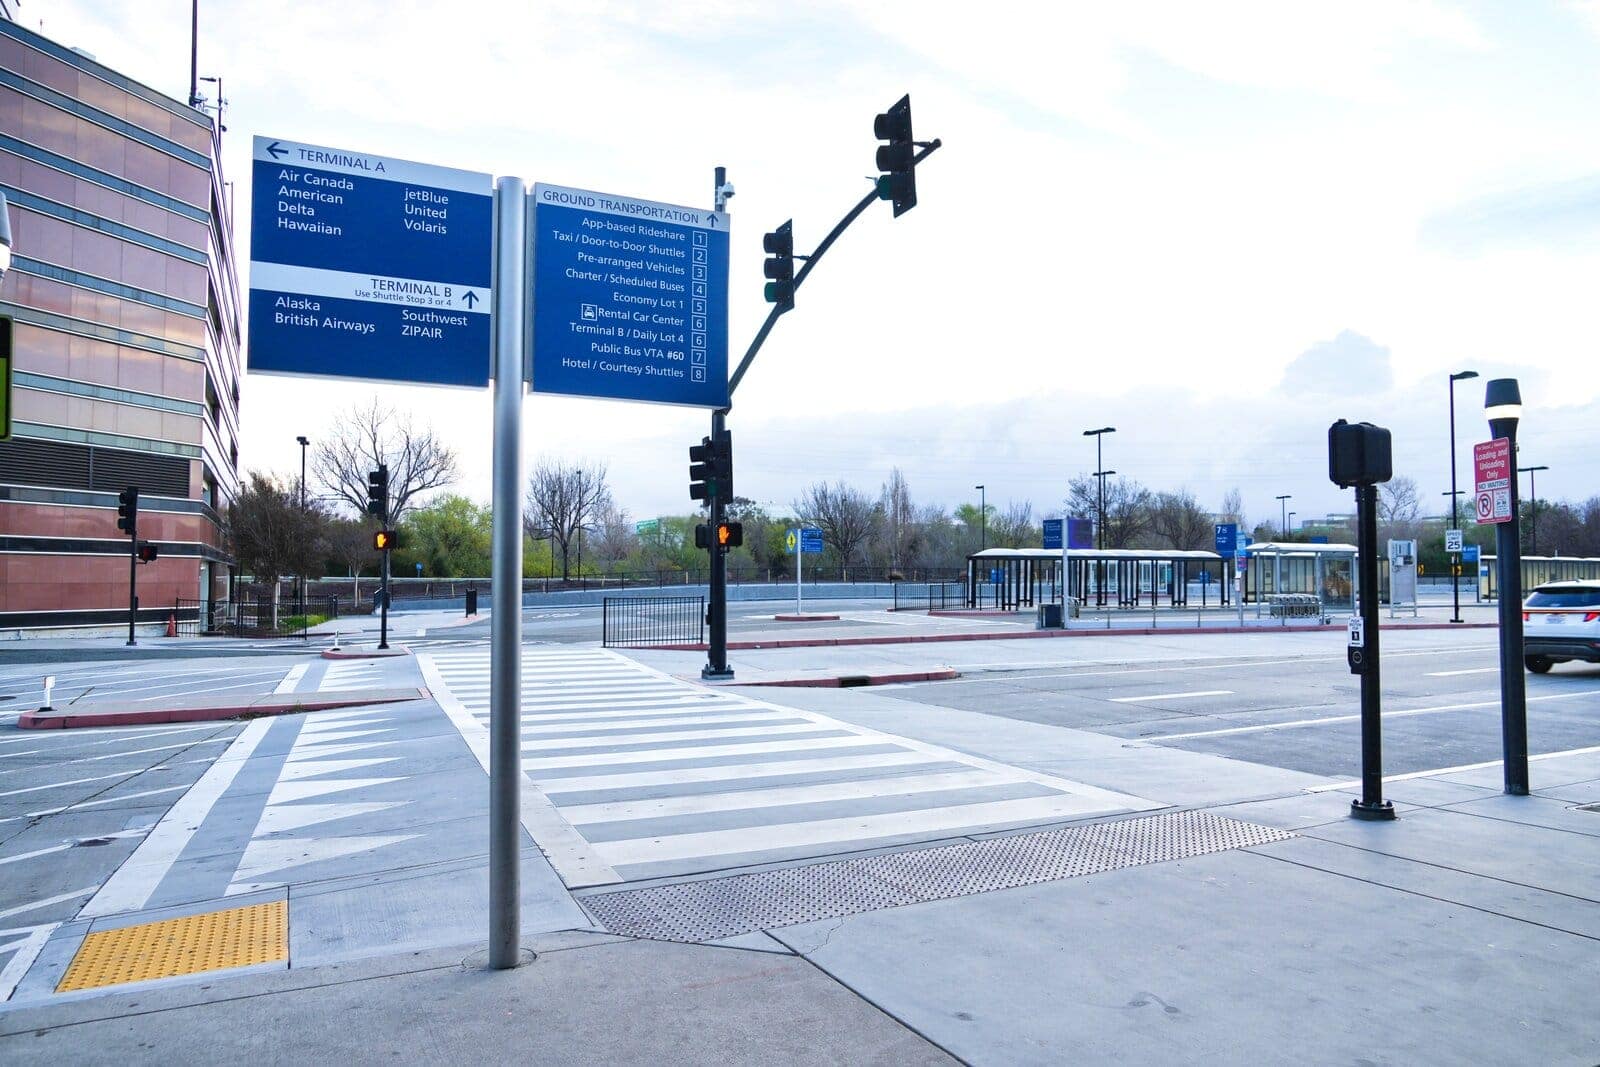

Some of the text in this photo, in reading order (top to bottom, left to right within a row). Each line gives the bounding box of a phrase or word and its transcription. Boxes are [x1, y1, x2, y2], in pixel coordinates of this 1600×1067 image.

[298, 148, 386, 173] TERMINAL A
[279, 169, 354, 190] Air Canada
[278, 186, 343, 204] American
[404, 188, 449, 205] jetBlue
[278, 201, 315, 216] Delta
[405, 205, 447, 219] United
[543, 190, 699, 224] GROUND TRANSPORTATION
[278, 217, 342, 236] Hawaiian
[404, 219, 447, 234] Volaris
[582, 217, 703, 244] App-based Rideshare 1
[553, 230, 573, 242] Taxi
[582, 235, 647, 252] Door-to-Door
[648, 244, 686, 258] Shuttles
[697, 252, 703, 261] 2
[578, 252, 703, 277] Pre-arranged Vehicles 3
[370, 278, 452, 298] TERMINAL B
[565, 268, 603, 281] Charter
[610, 274, 658, 289] Scheduled
[660, 280, 685, 292] Buses
[696, 285, 703, 294] 4
[275, 296, 321, 311] Alaska
[354, 290, 370, 298] Use
[372, 291, 404, 302] Shuttle
[406, 295, 426, 305] Stop
[428, 297, 433, 305] 3
[613, 293, 702, 311] Economy Lot 1 5
[275, 312, 376, 335] British Airways
[402, 309, 468, 326] Southwest
[598, 308, 702, 328] Rental Car Center 6
[402, 325, 443, 339] ZIPAIR
[570, 322, 615, 336] Terminal
[618, 328, 624, 337] B
[633, 330, 658, 343] Daily
[660, 332, 676, 342] Lot
[678, 334, 684, 343] 4
[696, 336, 702, 345] 6
[591, 342, 702, 362] Public Bus VTA #60 7
[562, 357, 590, 369] Hotel
[600, 361, 643, 376] Courtesy
[645, 366, 684, 378] Shuttles
[696, 370, 702, 379] 8
[1486, 471, 1499, 479] Only
[1448, 541, 1461, 550] 25
